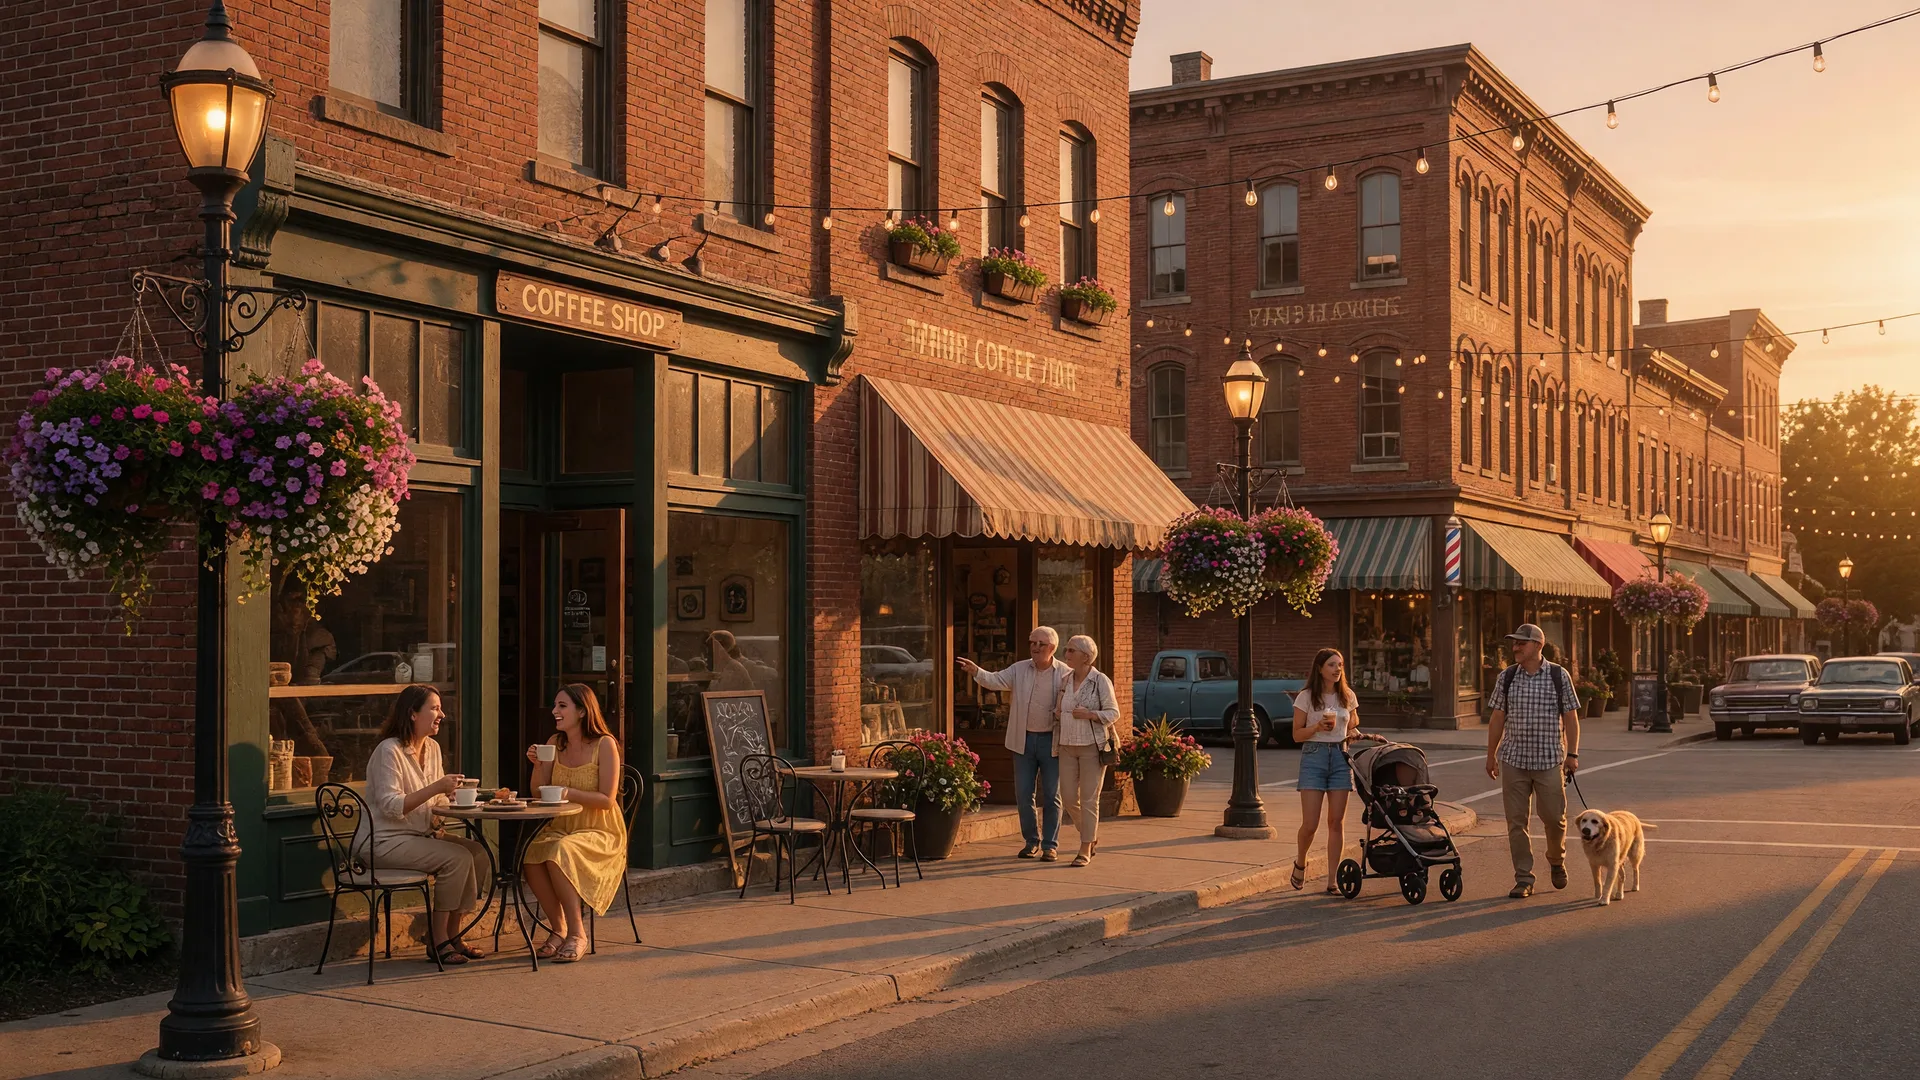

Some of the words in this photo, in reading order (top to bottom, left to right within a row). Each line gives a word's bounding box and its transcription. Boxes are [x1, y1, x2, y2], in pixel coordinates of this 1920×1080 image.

[522, 284, 604, 326] COFFEE
[611, 304, 664, 337] SHOP
[975, 340, 1035, 383] COFFEE
